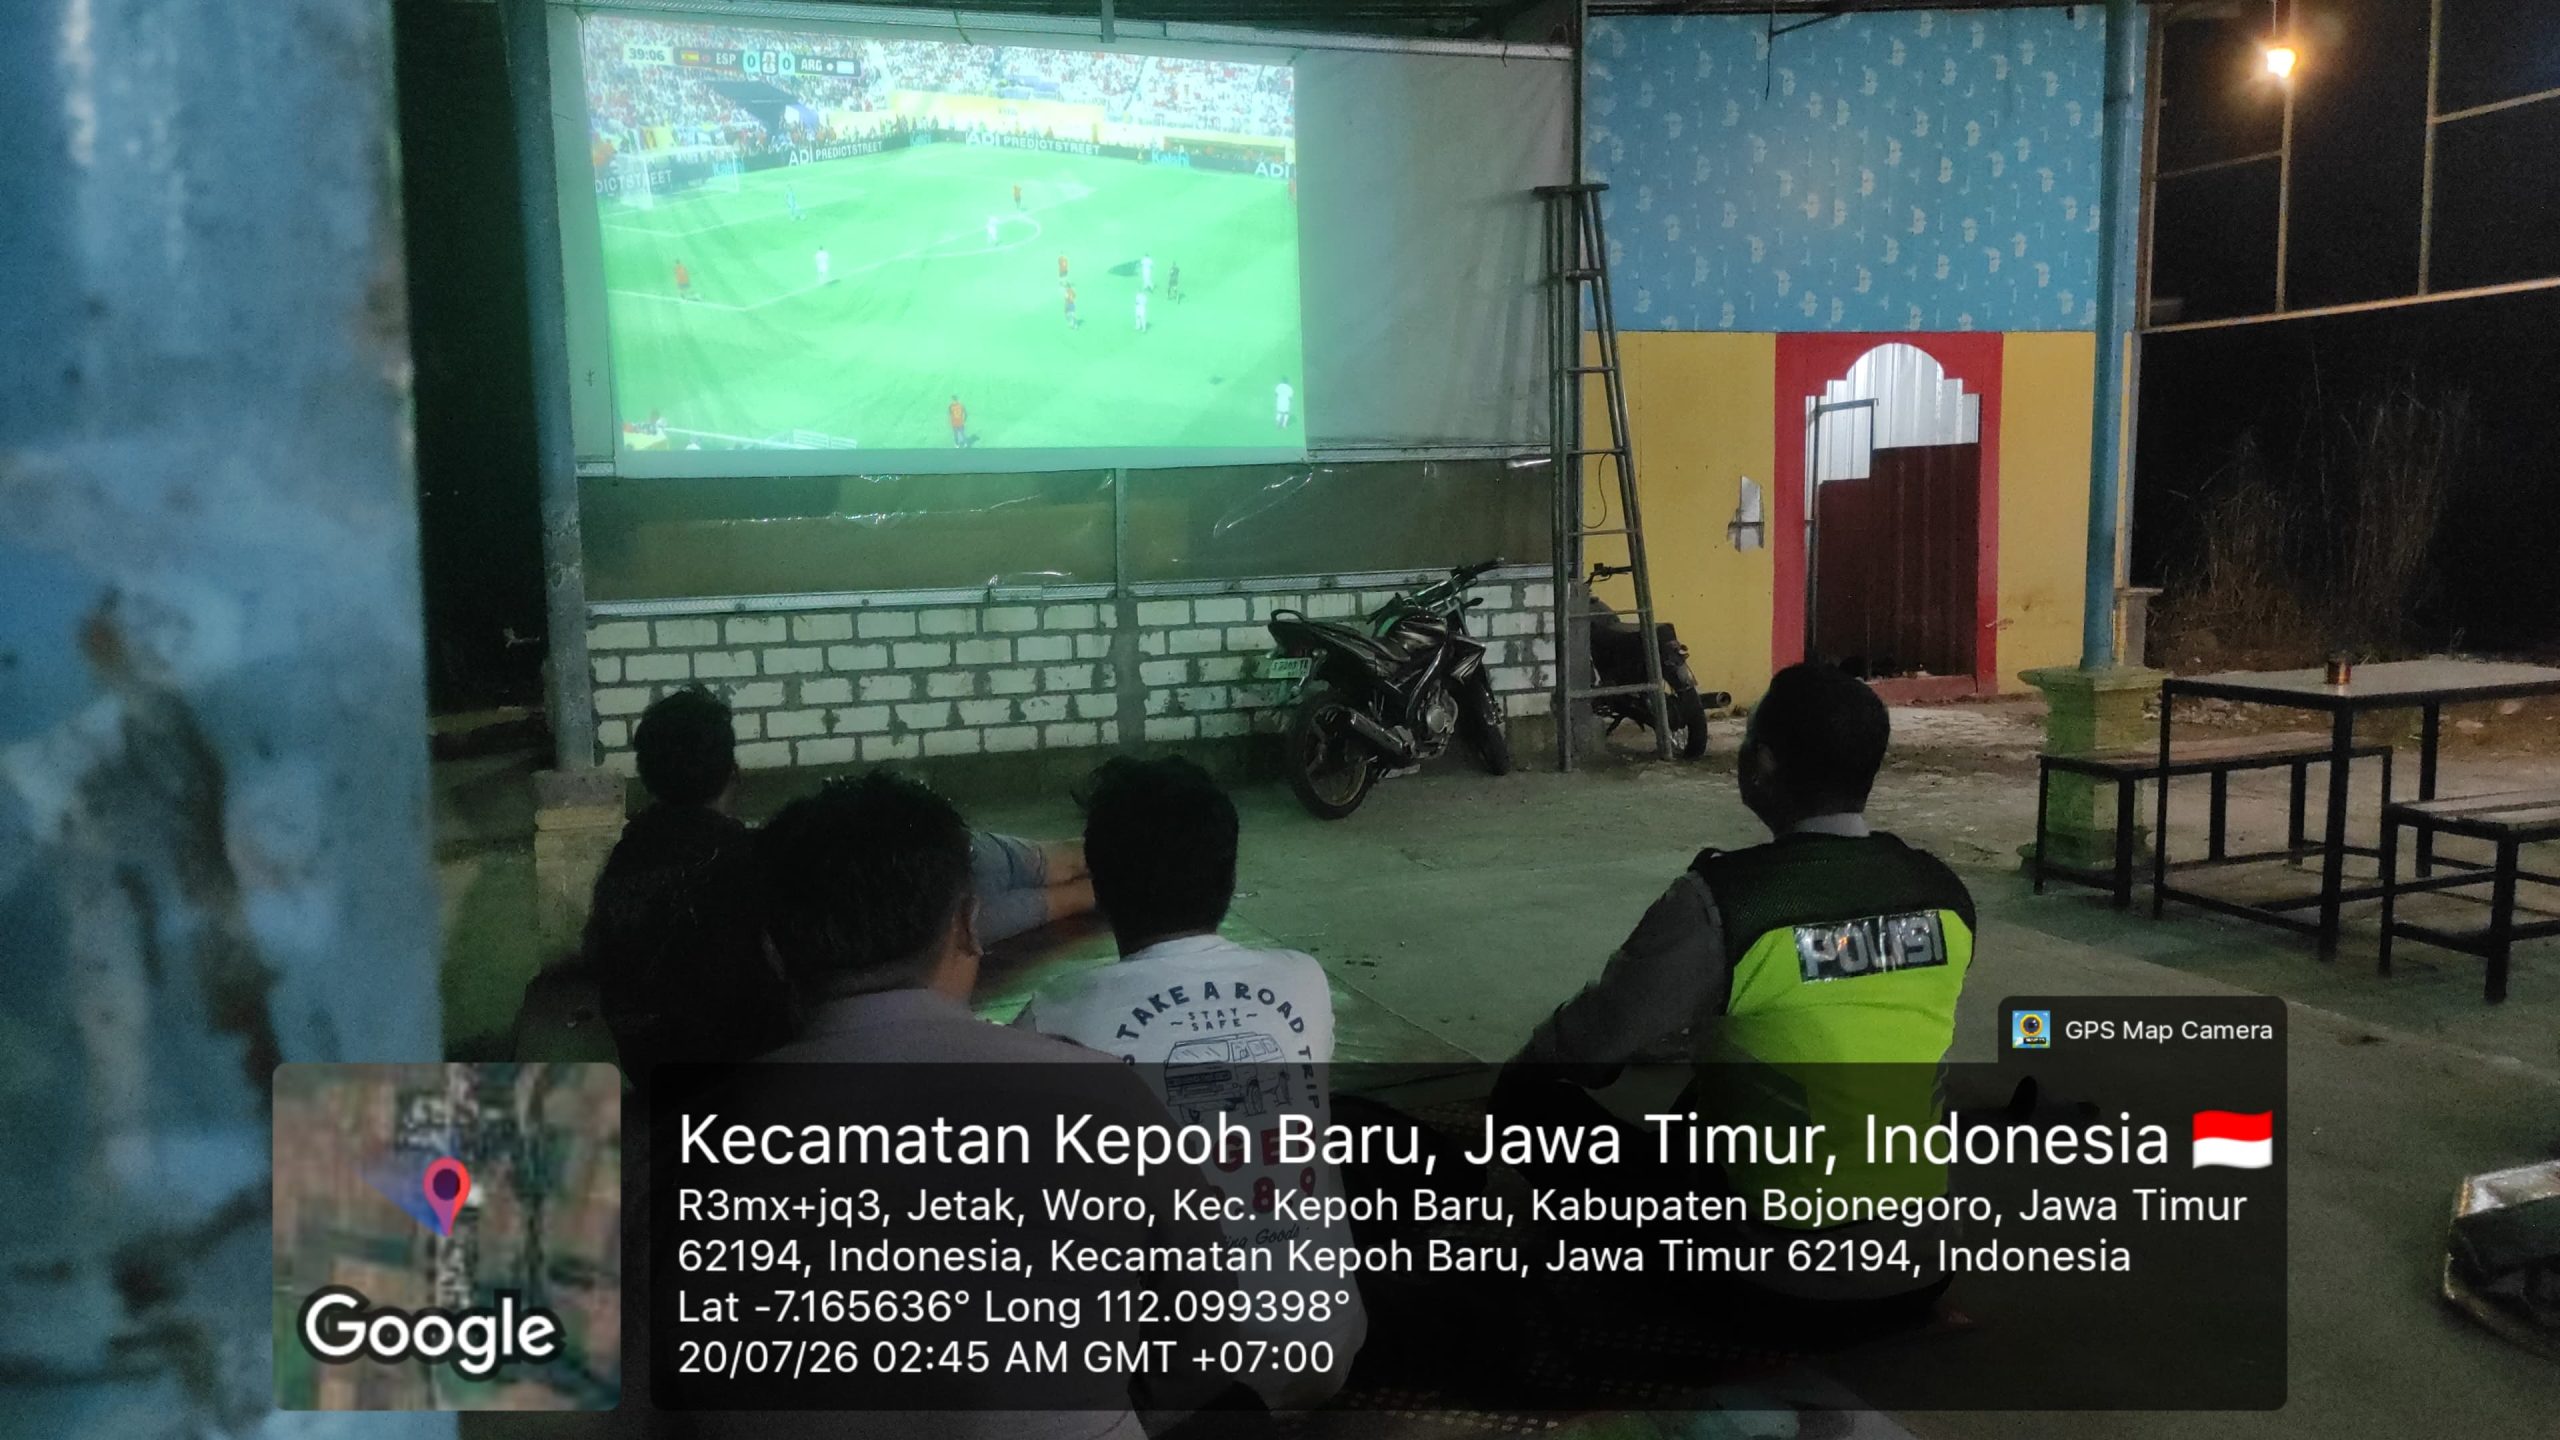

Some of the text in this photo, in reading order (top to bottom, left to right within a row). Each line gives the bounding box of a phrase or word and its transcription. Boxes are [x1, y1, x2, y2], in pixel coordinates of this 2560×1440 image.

[715, 51, 737, 66] ESP
[746, 54, 756, 70] 0
[781, 56, 792, 71] 0
[800, 58, 823, 72] ARG
[1800, 915, 1944, 978] POLISI
[1188, 1007, 1238, 1021] STAY
[1191, 1018, 1242, 1031] SAFE
[1116, 981, 1320, 1109] TAKE A ROAD TRIP
